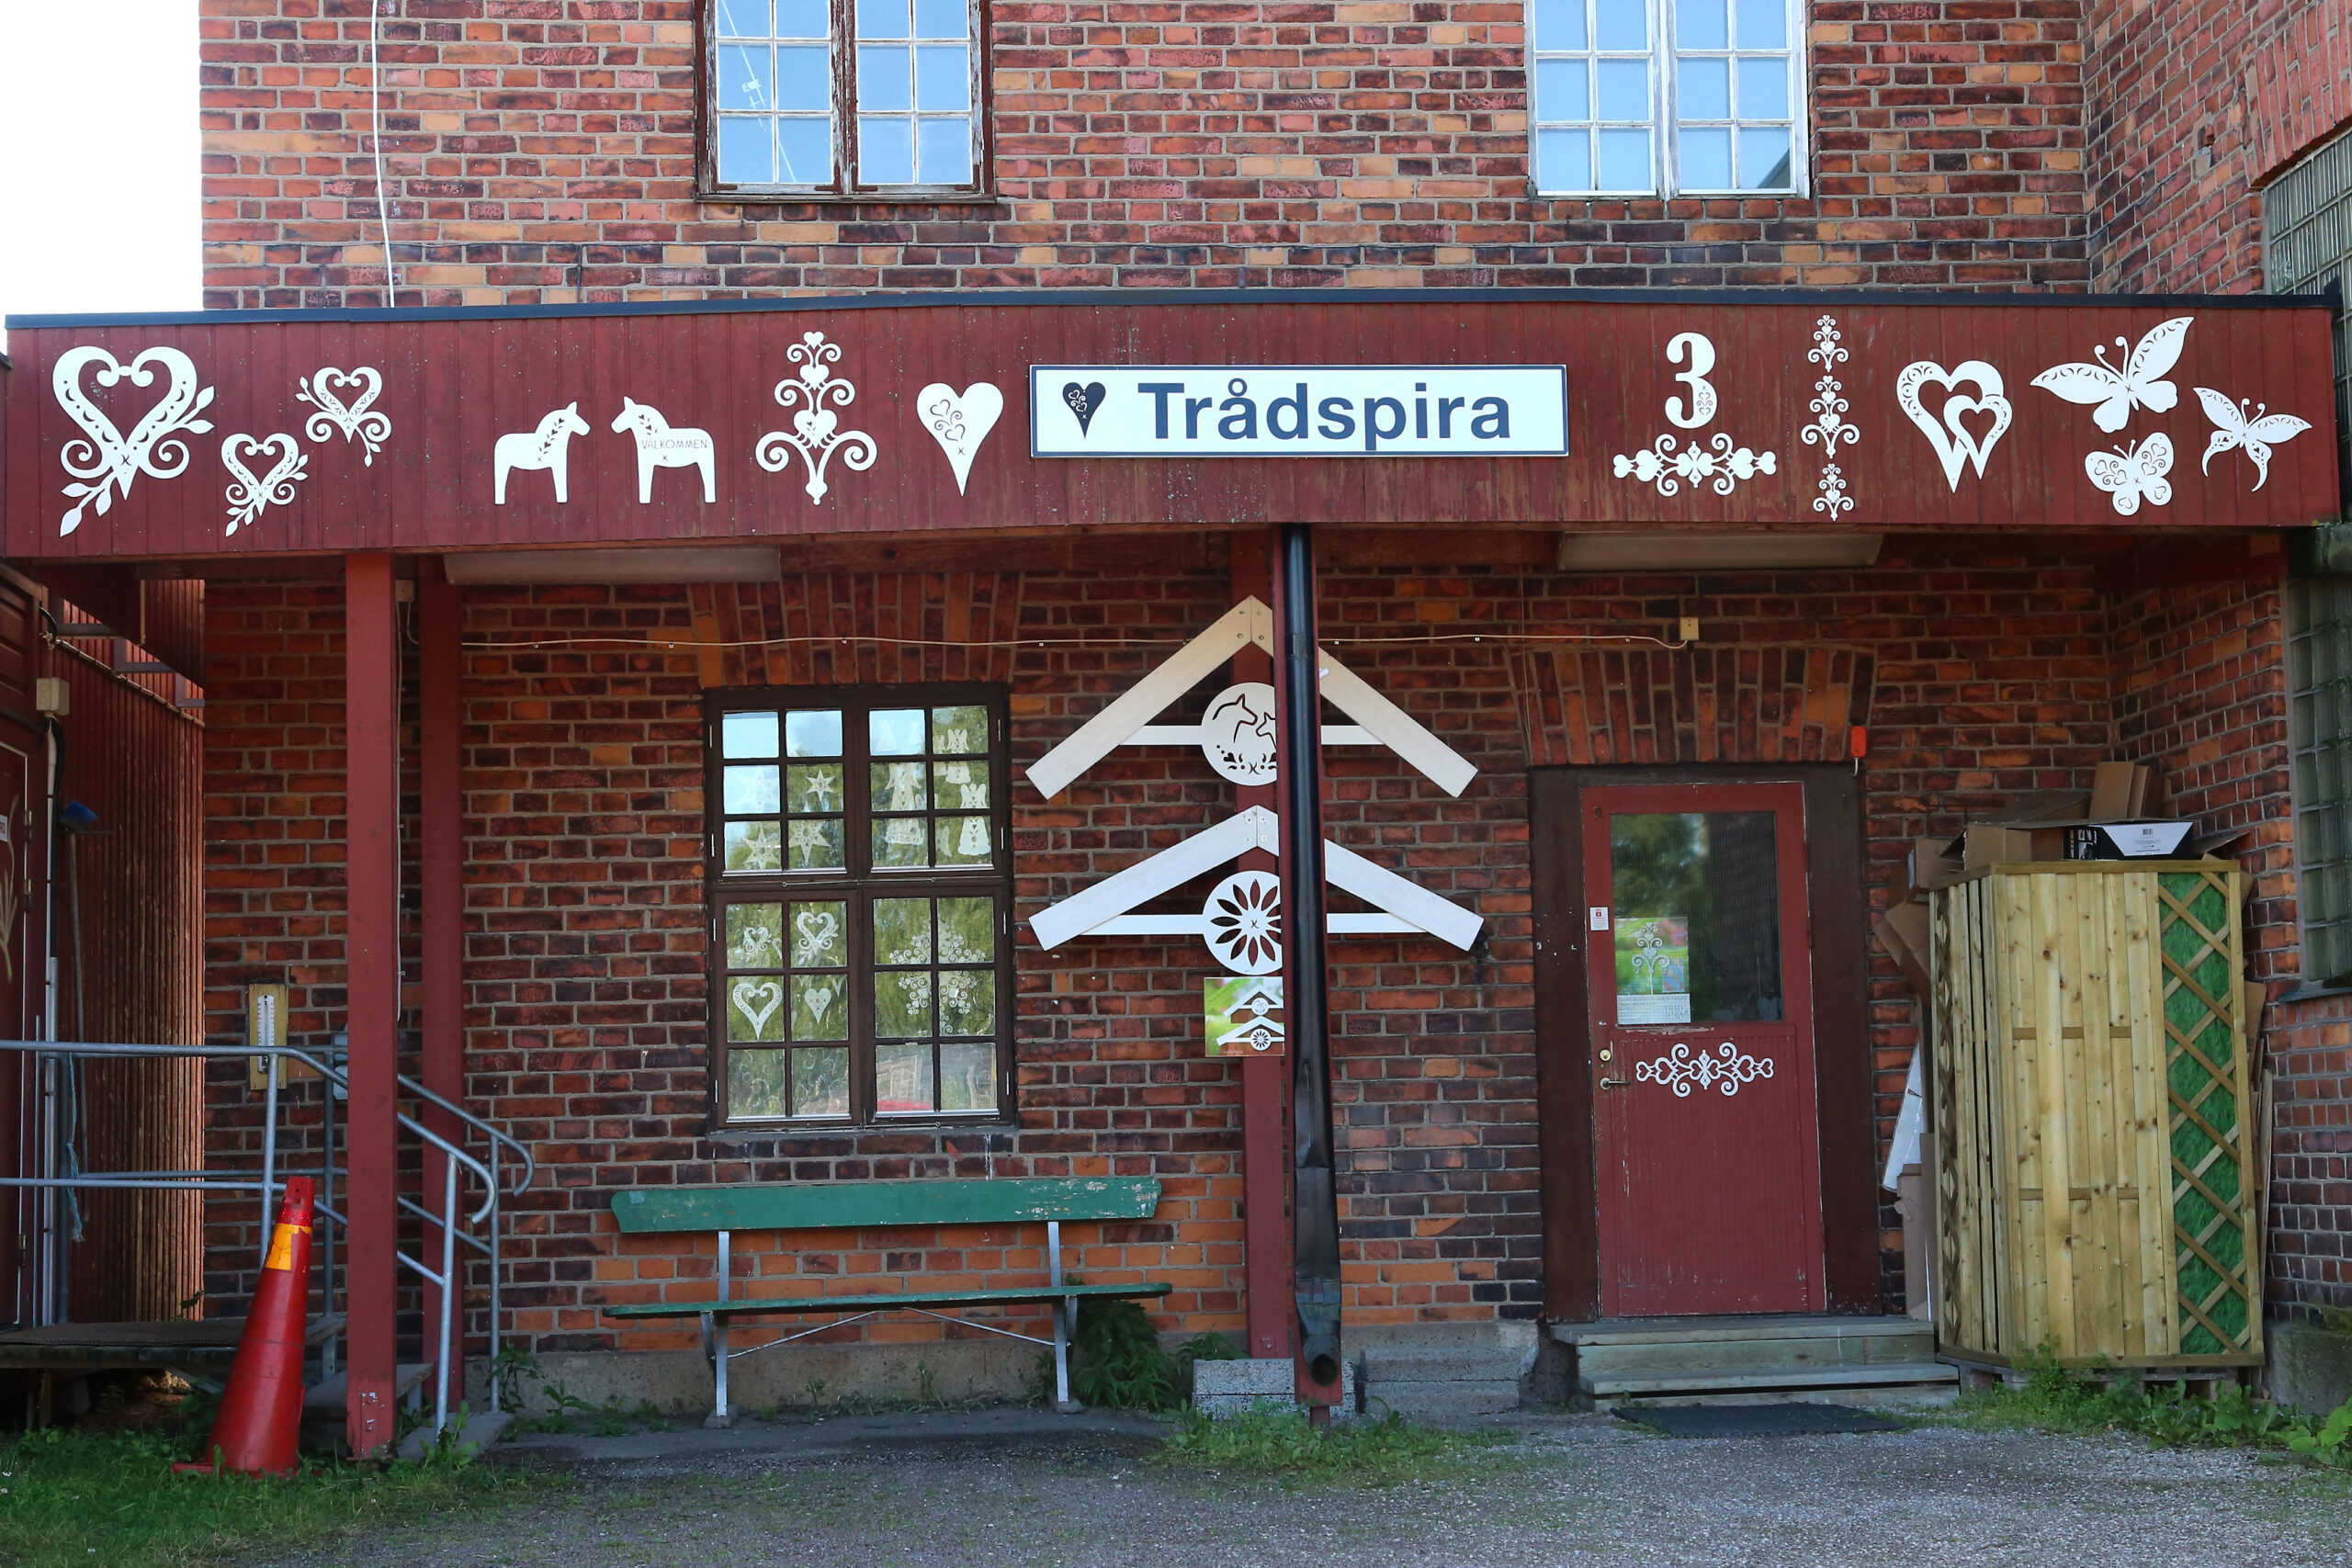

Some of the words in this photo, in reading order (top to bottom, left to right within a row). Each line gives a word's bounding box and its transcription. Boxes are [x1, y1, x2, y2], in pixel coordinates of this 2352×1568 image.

[1137, 378, 1510, 451] Trådspira
[1665, 332, 1718, 429] 3
[641, 438, 707, 449] VÄLKOMMEN
